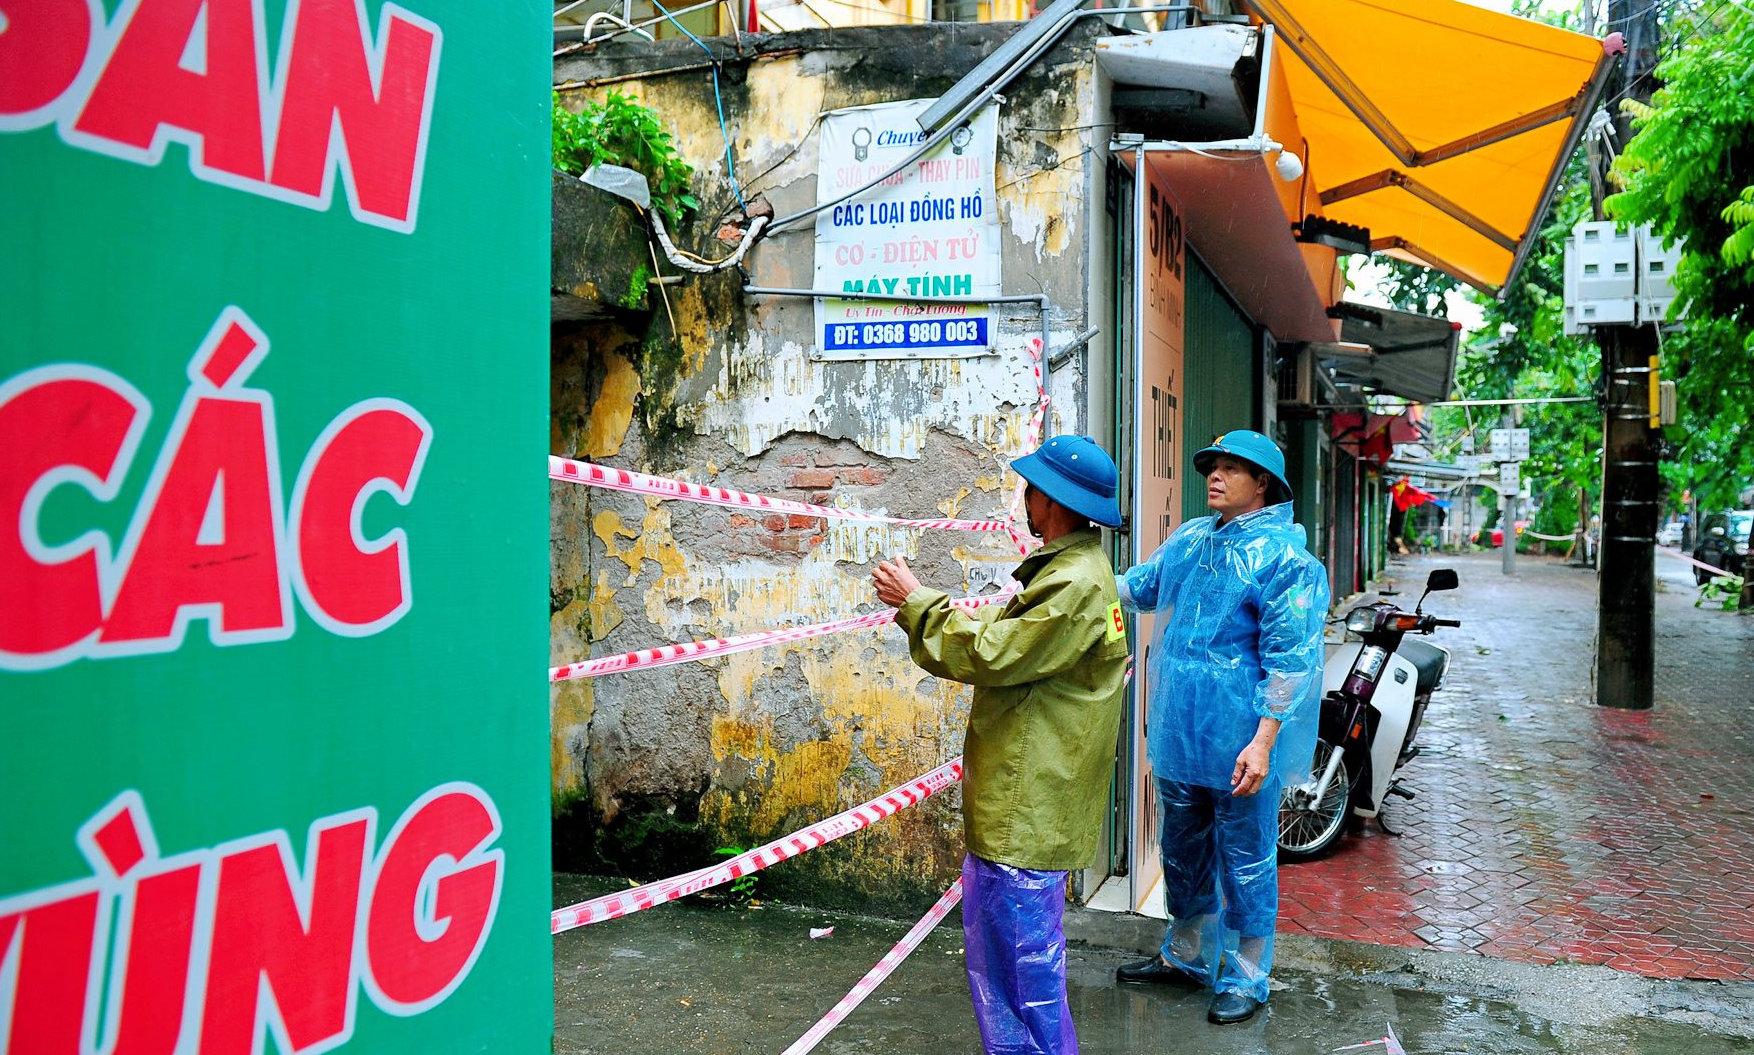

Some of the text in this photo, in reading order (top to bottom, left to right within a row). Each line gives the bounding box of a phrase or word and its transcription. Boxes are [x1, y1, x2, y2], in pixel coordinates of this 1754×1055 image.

[918, 160, 951, 183] THAY
[955, 157, 980, 181] PIN
[833, 187, 982, 229] CÁC LOẠI ĐỒNG HỒ
[835, 240, 864, 267] CƠ
[883, 234, 939, 268] ĐIỆN
[946, 228, 980, 260] TỬ
[842, 271, 972, 300] MÁY TÍNH
[834, 320, 978, 345] ĐT: 0368 980 003
[1151, 368, 1177, 480] THIẾT
[0, 305, 433, 672] CÁC
[0, 782, 504, 1055] ÙNG
